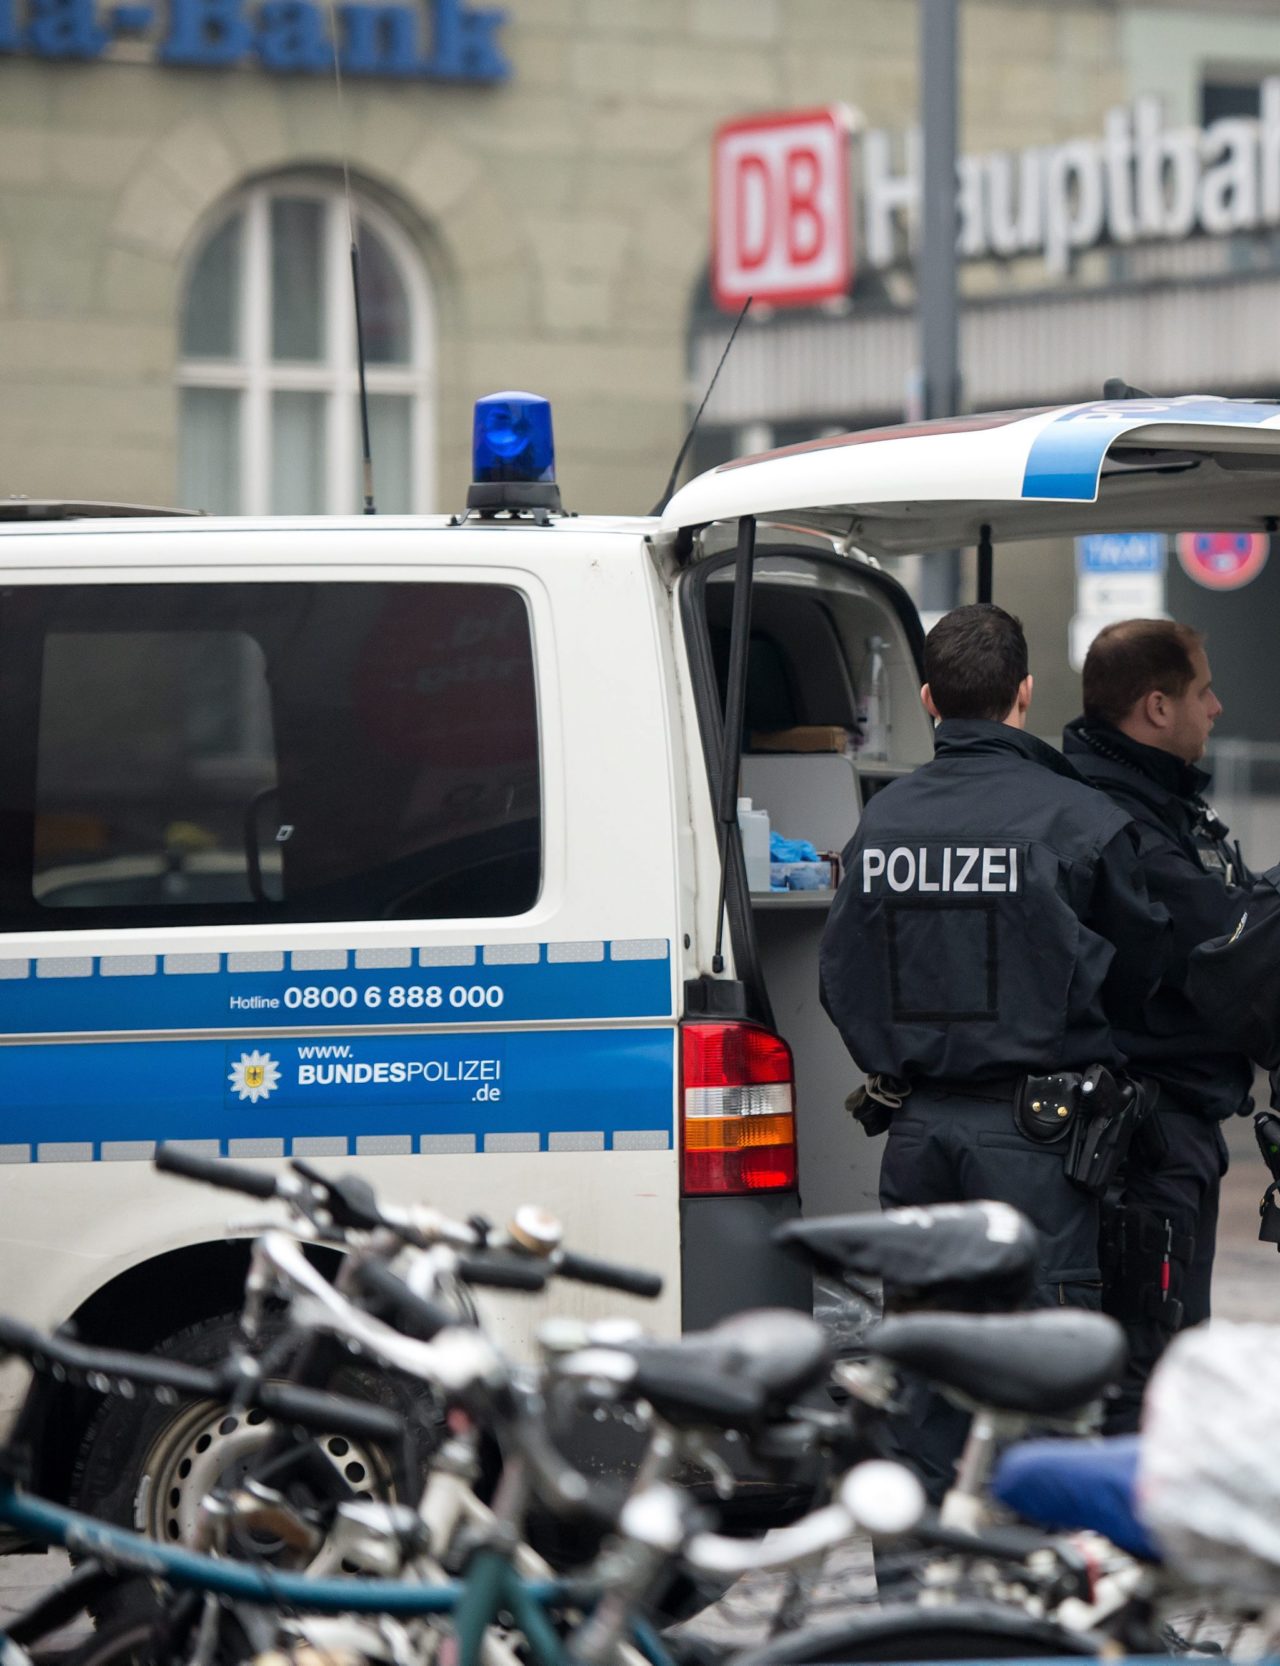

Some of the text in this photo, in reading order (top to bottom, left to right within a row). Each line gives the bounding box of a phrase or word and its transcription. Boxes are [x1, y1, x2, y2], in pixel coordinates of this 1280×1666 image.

[736, 148, 827, 270] DB
[863, 847, 1018, 893] POLIZEI
[229, 985, 504, 1010] Hotline 0800 6 888 000
[298, 1045, 354, 1060] www.
[298, 1060, 500, 1085] BUNDESPOLIZEI
[471, 1083, 501, 1102] .de
